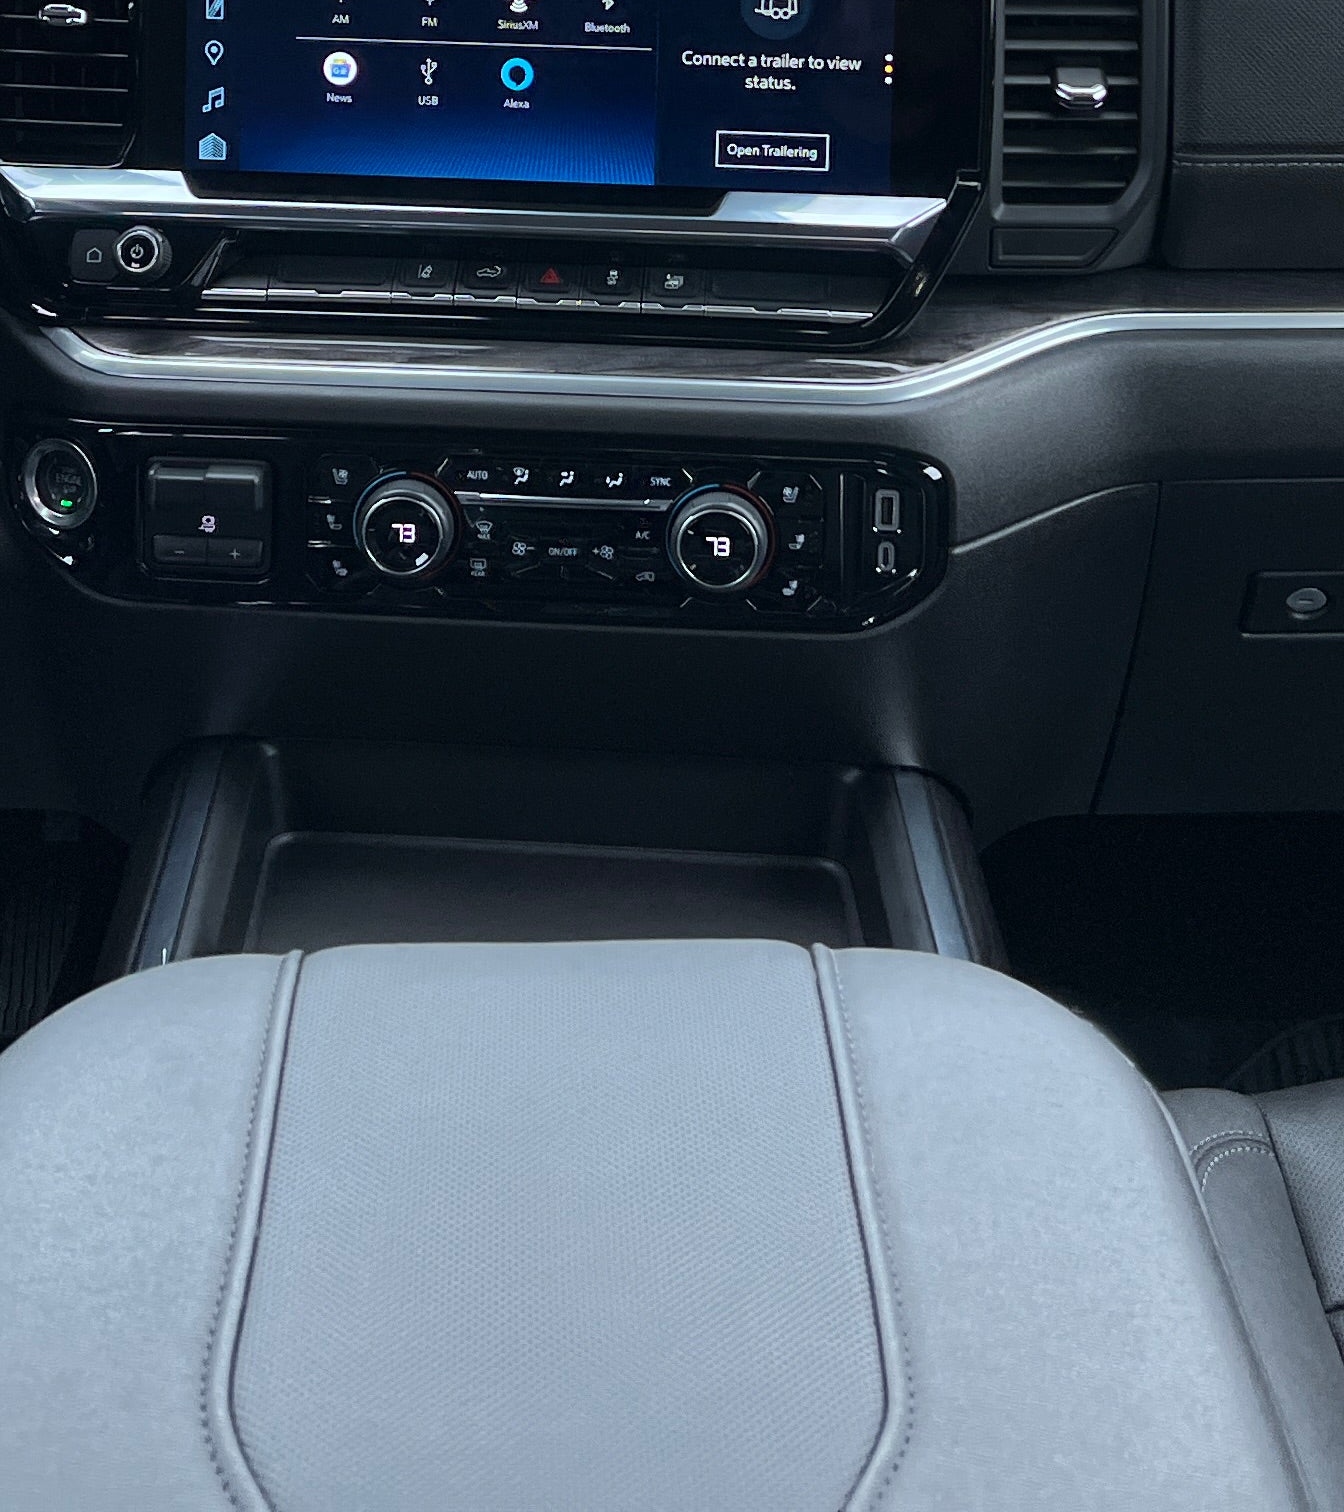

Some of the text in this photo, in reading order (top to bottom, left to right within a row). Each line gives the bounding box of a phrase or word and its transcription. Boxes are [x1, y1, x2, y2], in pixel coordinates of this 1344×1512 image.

[331, 14, 349, 25] AM
[421, 16, 438, 27] FM
[497, 18, 539, 30] SiriusXM
[584, 21, 630, 34] Bluetooth
[681, 50, 862, 71] Connect a trailer to view
[745, 75, 796, 90] status.
[326, 92, 353, 104] News
[418, 95, 439, 106] USB
[503, 98, 530, 109] Alexa
[726, 143, 818, 161] Open Trailering
[466, 470, 489, 481] AUTO
[650, 477, 672, 487] SYNC
[391, 523, 416, 543] 73
[635, 530, 651, 540] A/C
[548, 546, 578, 557] ON/OFF
[705, 536, 731, 557] 73
